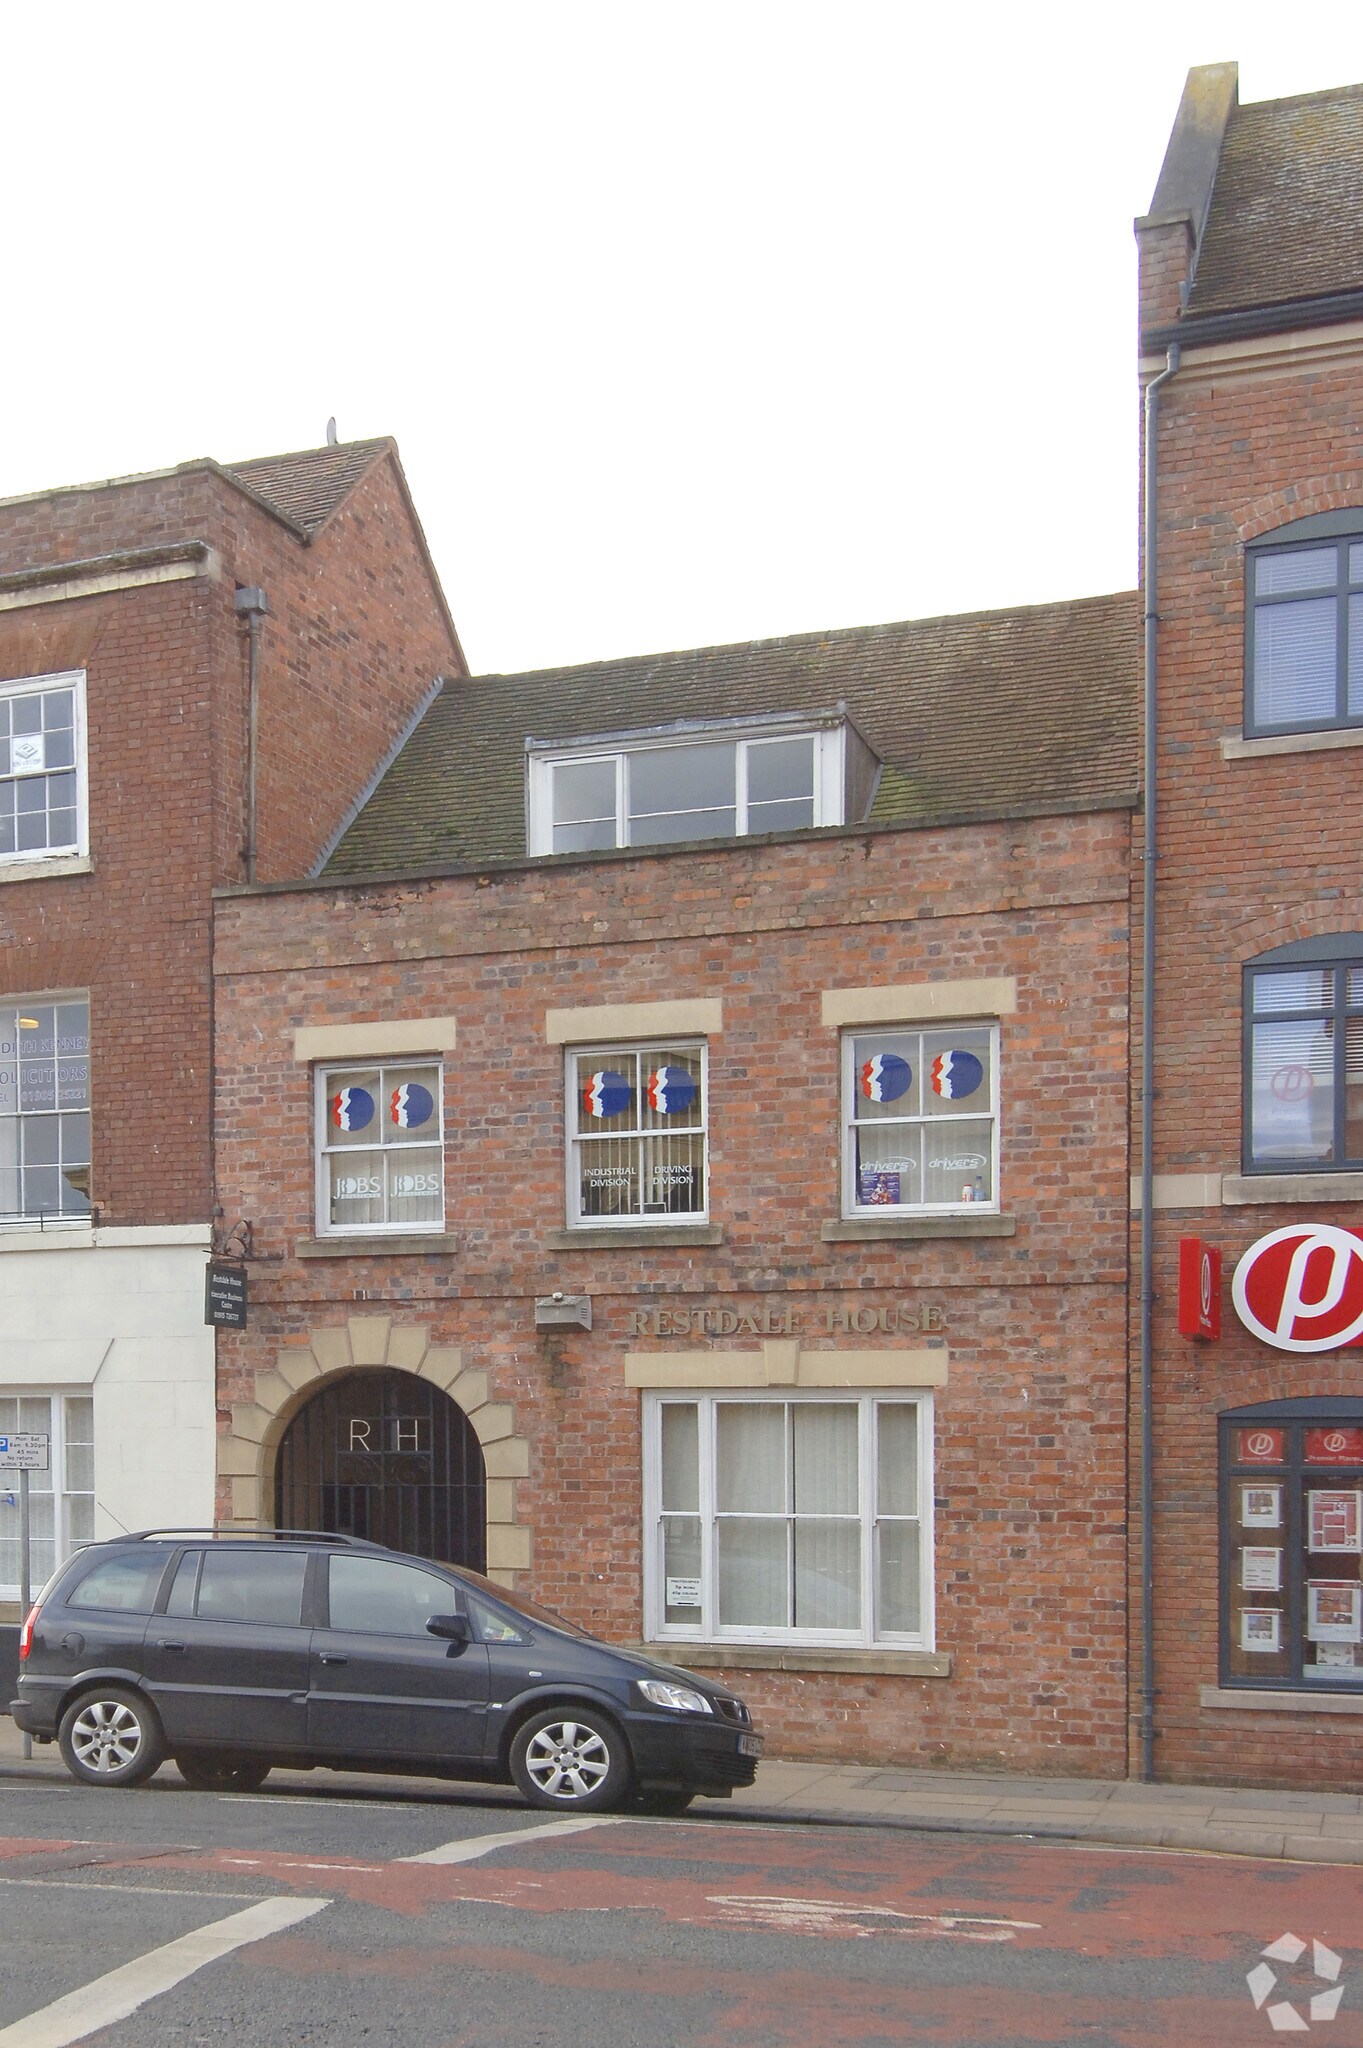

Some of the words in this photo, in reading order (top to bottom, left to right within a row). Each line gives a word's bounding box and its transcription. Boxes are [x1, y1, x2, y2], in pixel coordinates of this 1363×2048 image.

[40, 1036, 89, 1052] KENNEY
[654, 1165, 692, 1174] DRIVING
[859, 1160, 909, 1173] drivers
[929, 1158, 979, 1170] drivers
[584, 1167, 637, 1177] INDUSTRIAL
[590, 1178, 631, 1187] DIVISION
[653, 1176, 694, 1185] DIVISION
[213, 1274, 229, 1284] Restdale
[230, 1277, 241, 1286] House
[628, 1309, 802, 1336] RESTDALE
[826, 1305, 945, 1333] HOUSE
[350, 1419, 371, 1451] R
[397, 1419, 418, 1451] H
